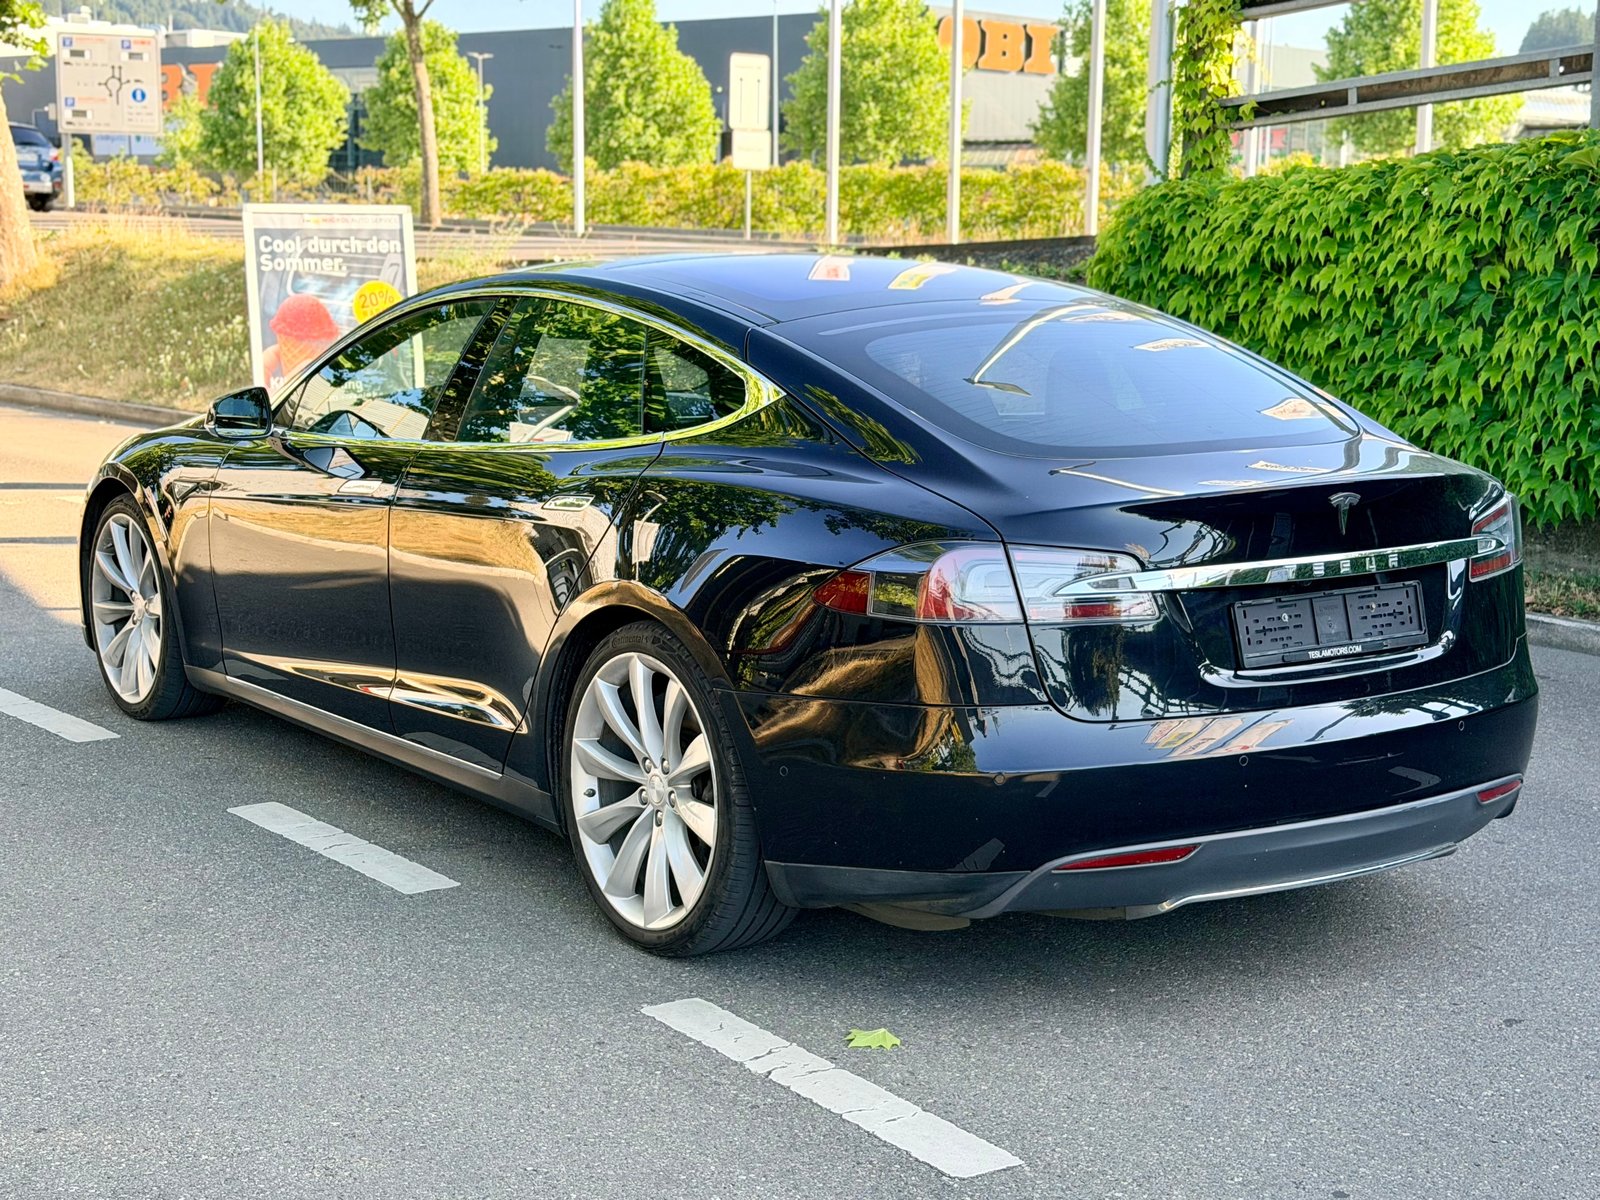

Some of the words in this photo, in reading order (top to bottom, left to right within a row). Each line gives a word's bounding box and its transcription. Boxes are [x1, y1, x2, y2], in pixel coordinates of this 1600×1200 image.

[938, 15, 1061, 75] OBI
[259, 235, 302, 253] Cool
[307, 236, 361, 253] durch
[366, 236, 400, 253] den
[260, 254, 347, 271] Sommer.
[359, 289, 395, 309] 20%
[1308, 645, 1362, 659] TESLAMOTORS.COM
